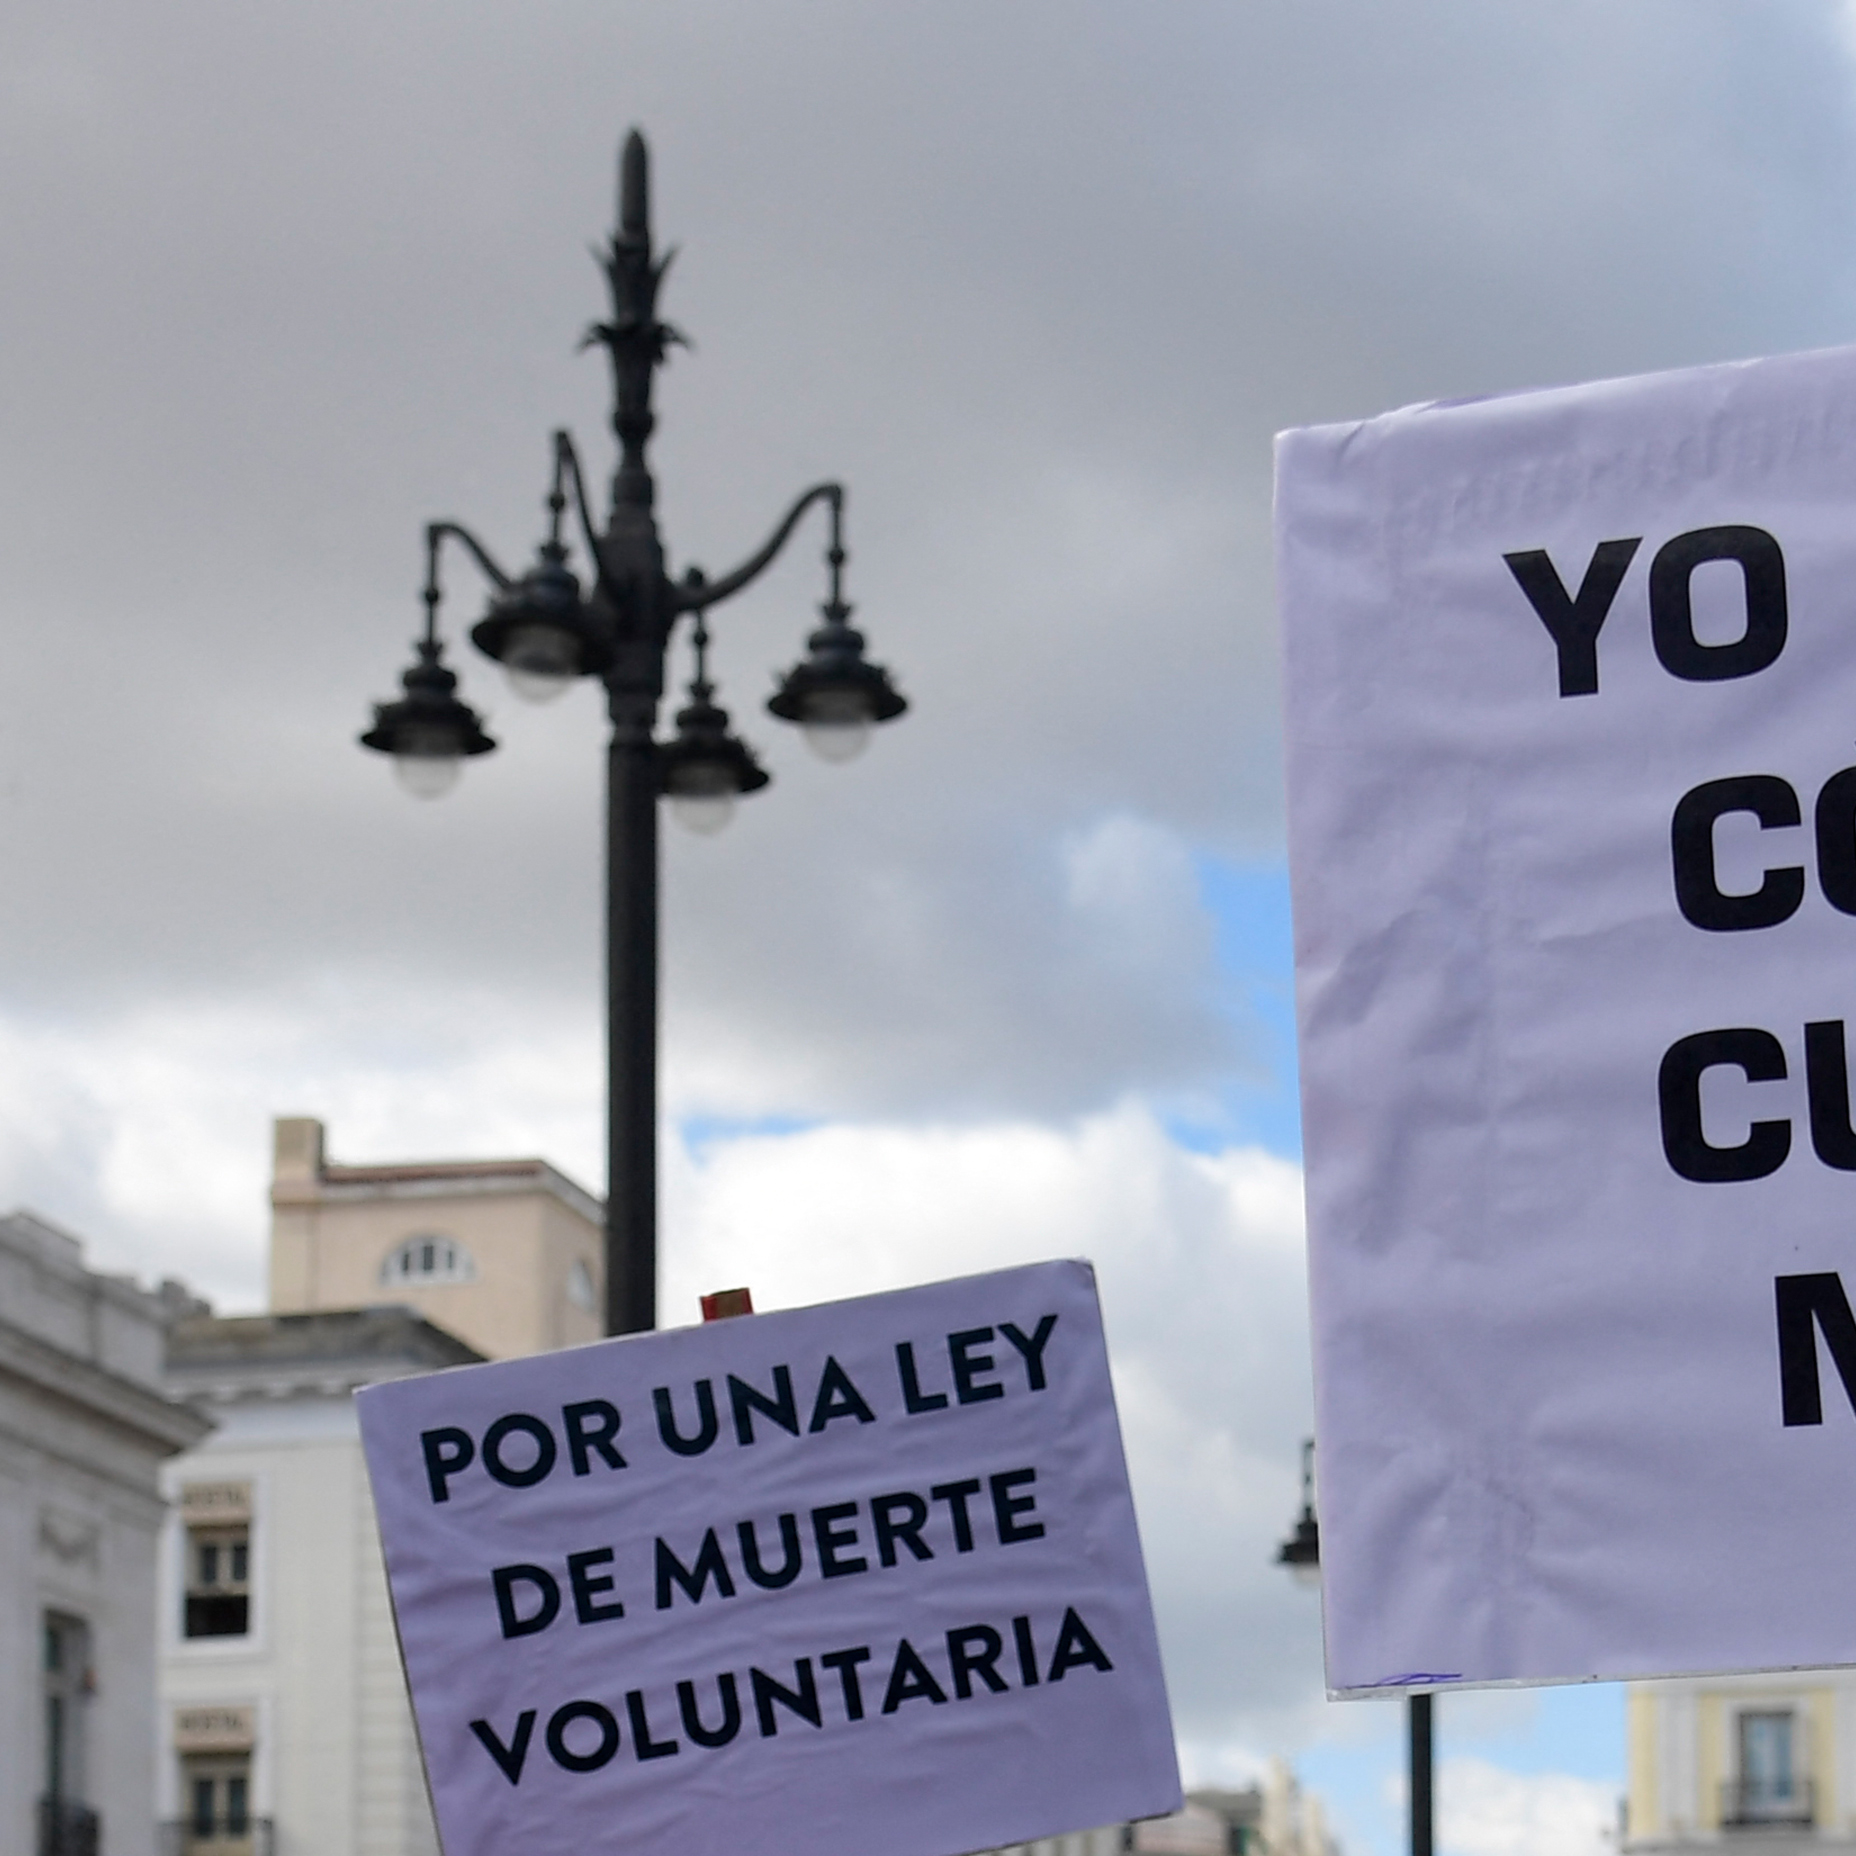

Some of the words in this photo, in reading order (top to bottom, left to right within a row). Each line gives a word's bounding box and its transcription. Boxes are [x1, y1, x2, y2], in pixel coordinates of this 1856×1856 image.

[1503, 526, 1788, 697] YO
[420, 1399, 628, 1504] POR
[652, 1355, 877, 1457] UNA
[895, 1313, 1059, 1415] LEY
[491, 1546, 625, 1641] DE
[655, 1467, 1046, 1610] MUERTE
[468, 1606, 1114, 1786] VOLUNTARIA
